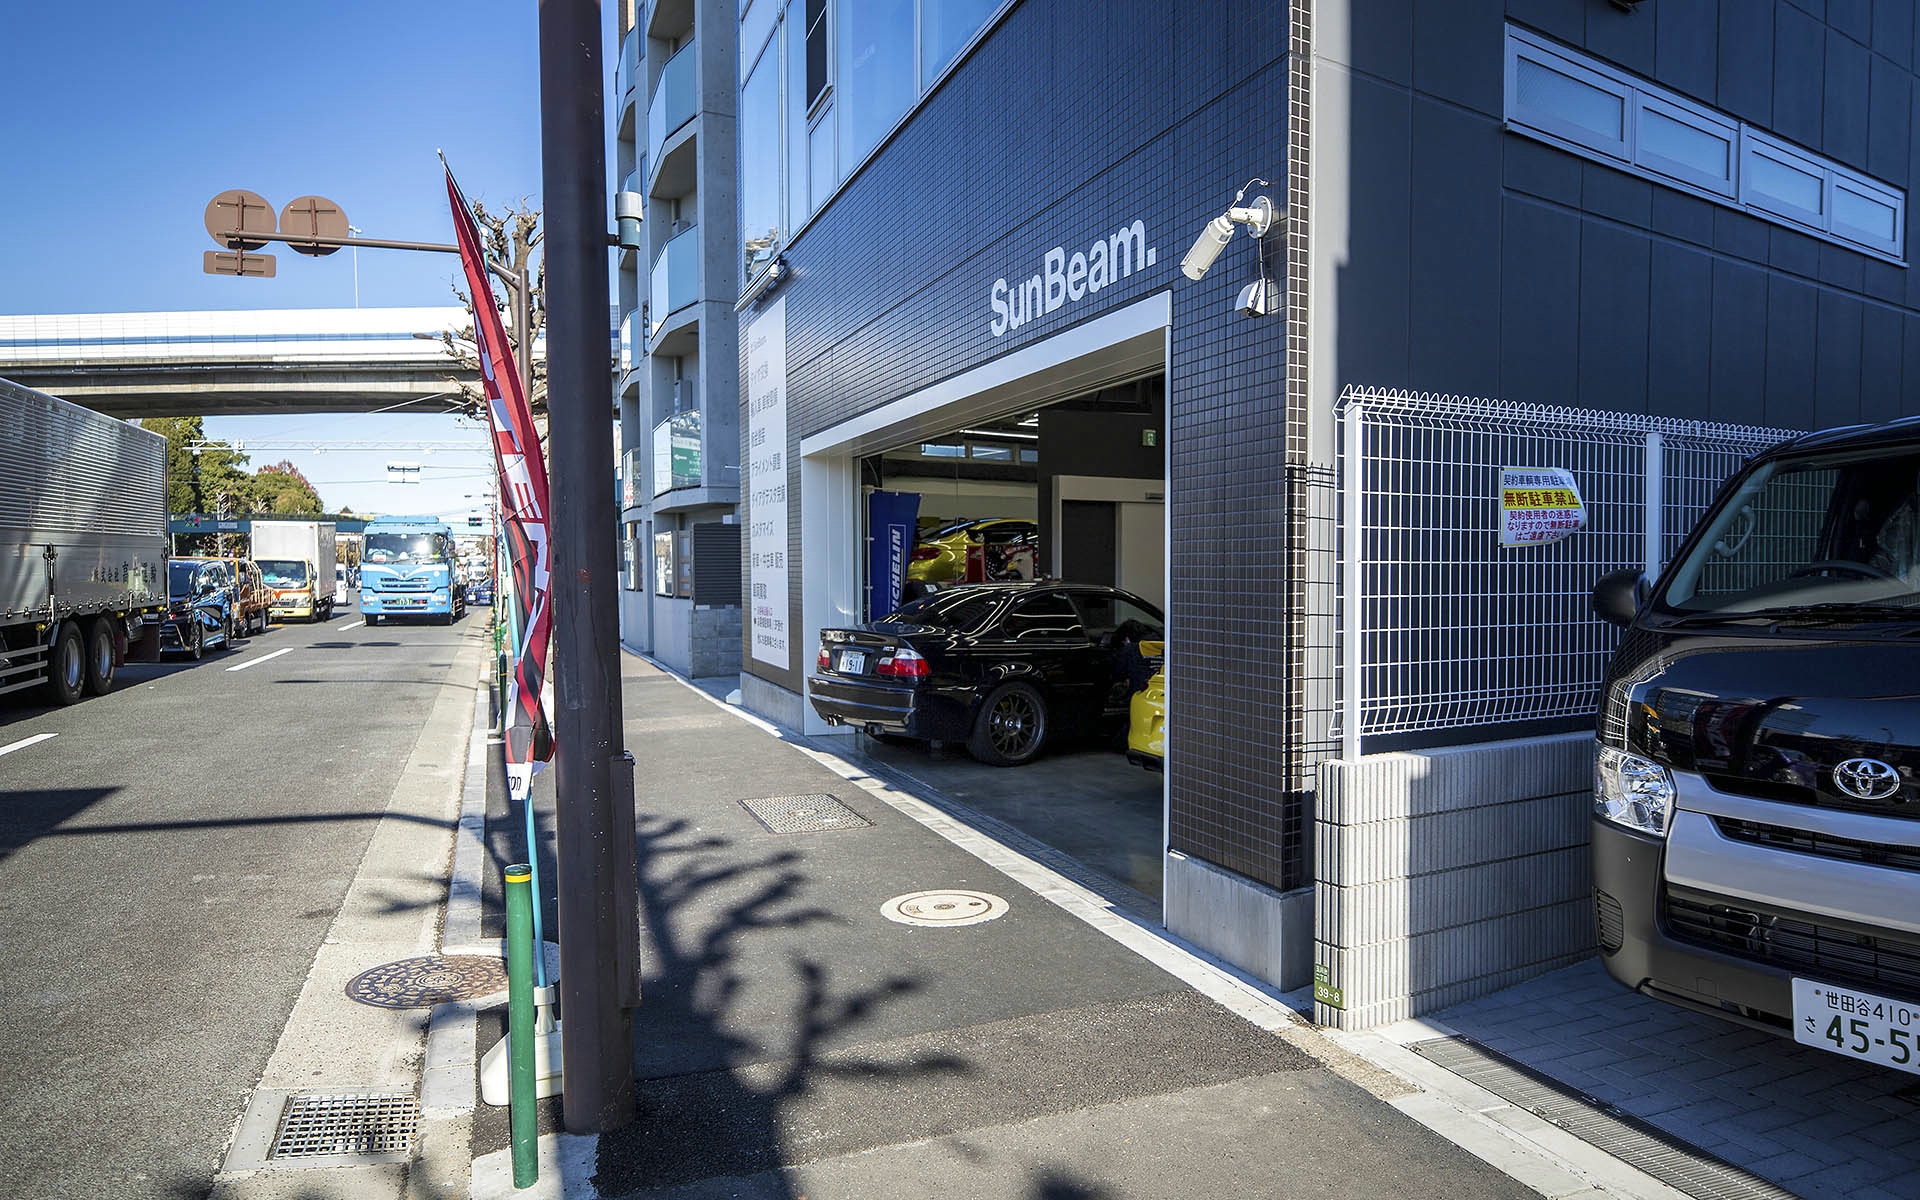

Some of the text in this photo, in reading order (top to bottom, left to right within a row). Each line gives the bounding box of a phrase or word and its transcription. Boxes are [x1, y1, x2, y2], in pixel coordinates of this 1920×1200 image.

[990, 219, 1157, 337] SunBeam.
[1504, 491, 1579, 506] 無断駐車禁止
[1509, 510, 1579, 521] 契約使用者の迷惑に
[752, 520, 774, 538] カスタマイズ
[1508, 520, 1579, 530] なりますので無断駐車
[892, 529, 901, 612] ICHELIN
[1318, 986, 1340, 1002] 39-8
[1804, 1014, 1920, 1067] さ 45-5
